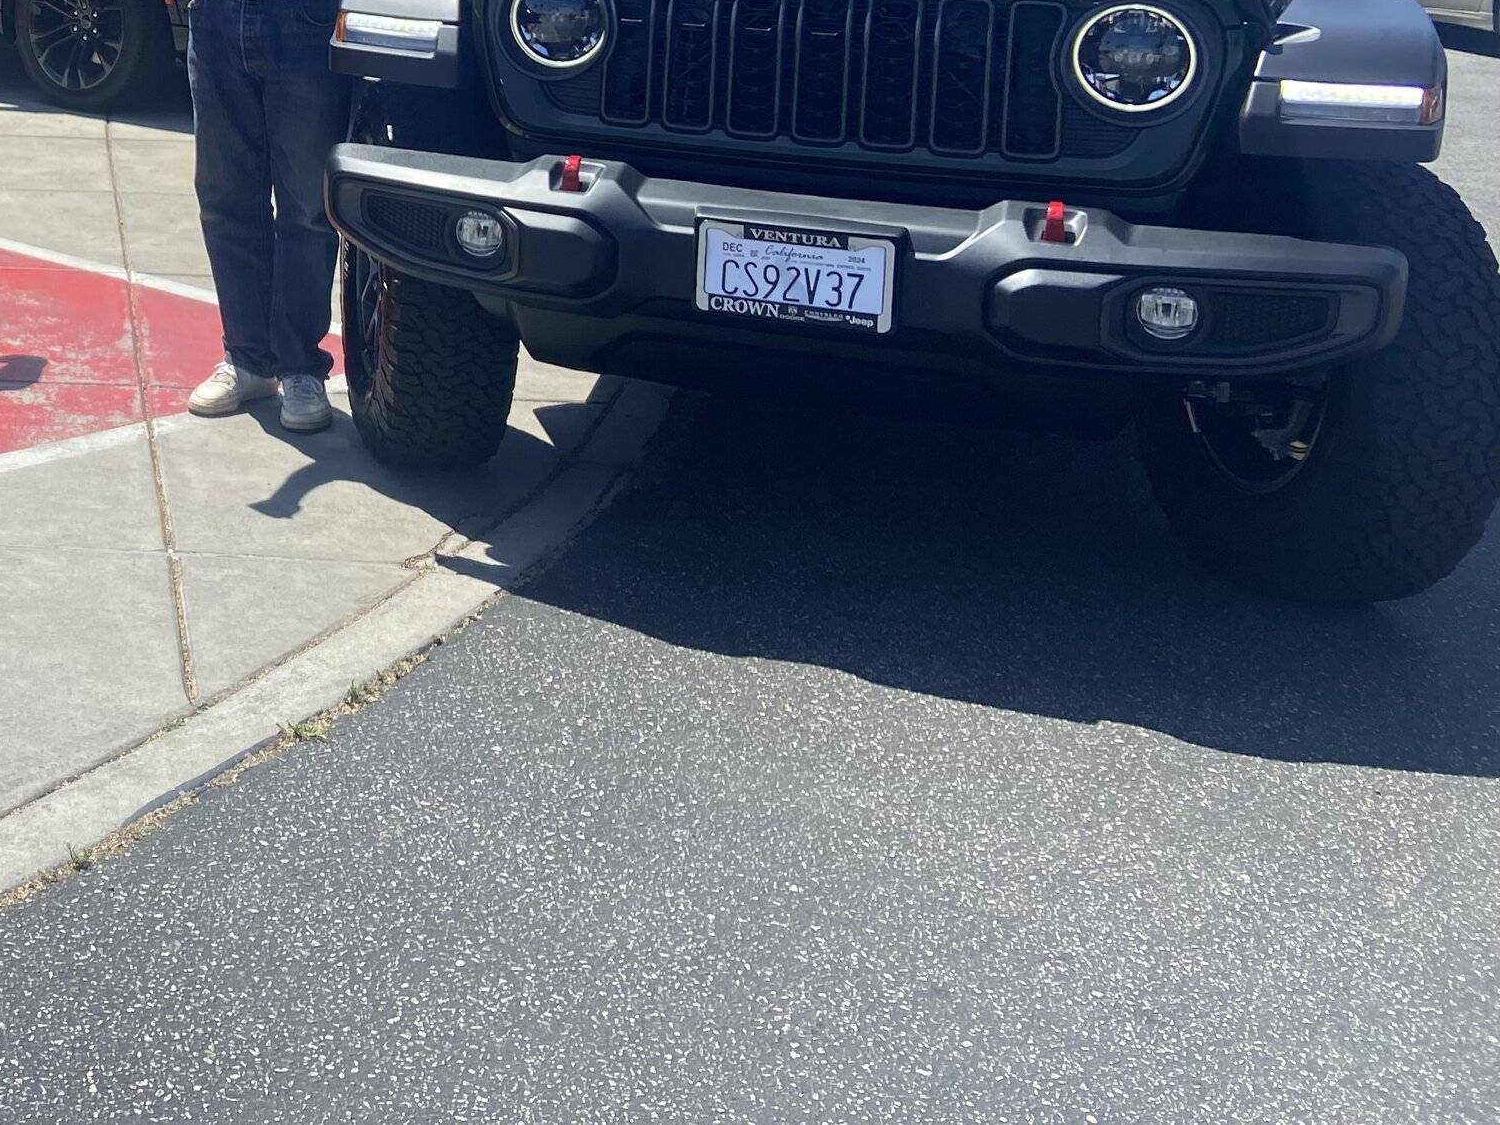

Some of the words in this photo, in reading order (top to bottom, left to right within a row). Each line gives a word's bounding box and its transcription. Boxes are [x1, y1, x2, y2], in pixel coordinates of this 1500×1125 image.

[749, 228, 841, 248] VENTURA
[722, 241, 743, 253] DEC
[765, 245, 824, 262] California
[721, 259, 865, 309] CS92V37
[710, 296, 780, 318] CROWN
[849, 315, 874, 328] Jeep
